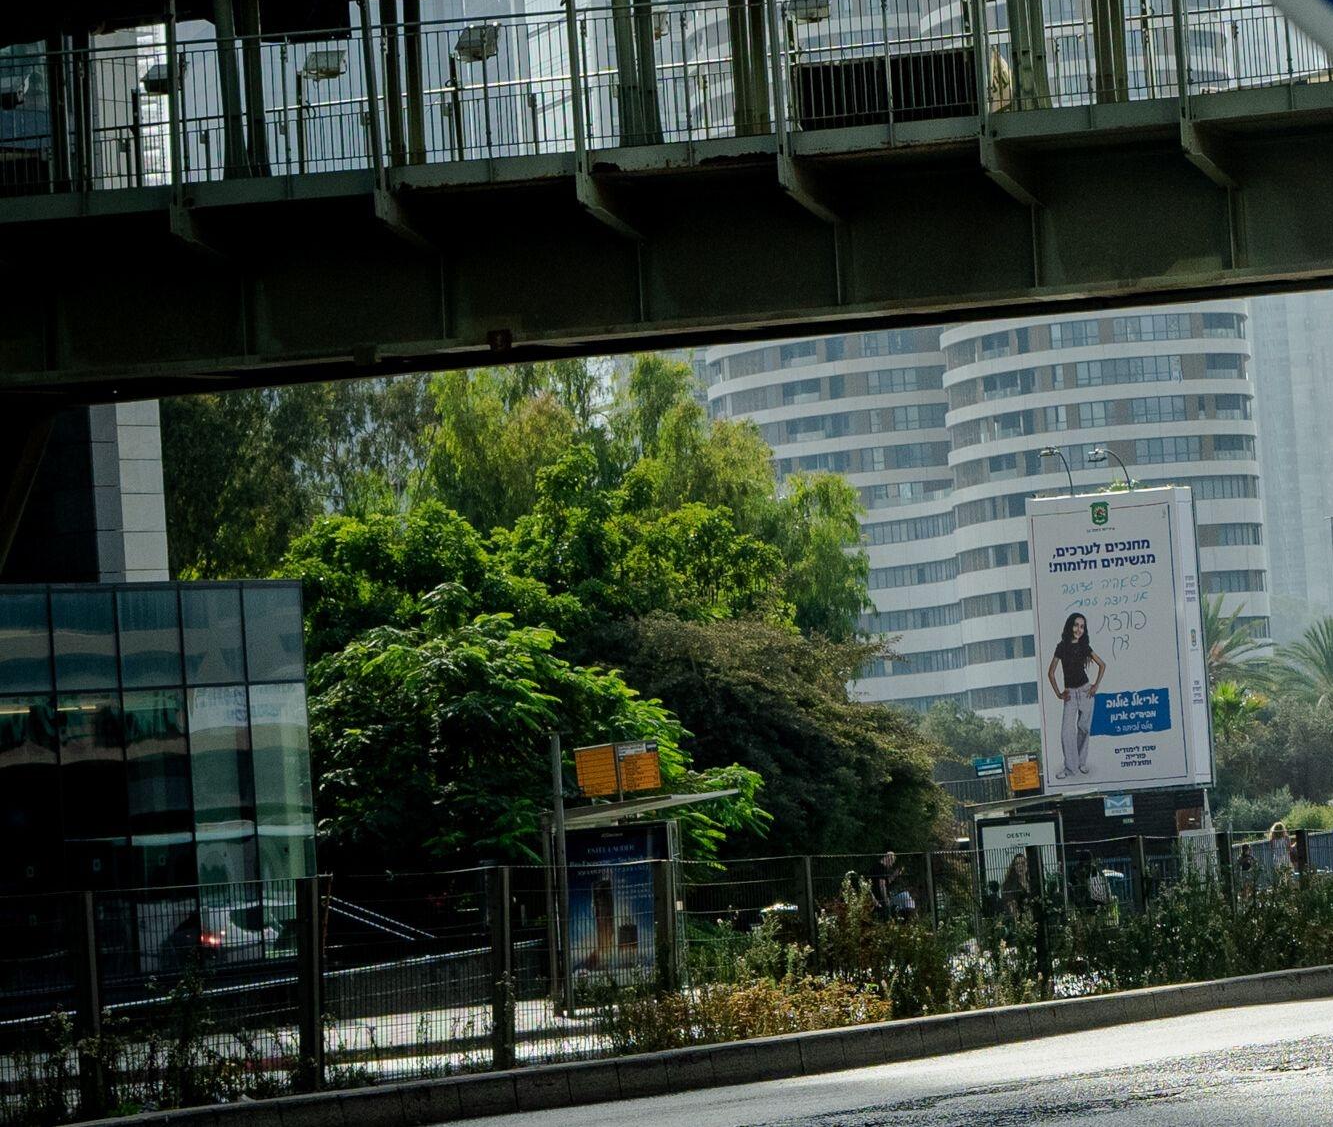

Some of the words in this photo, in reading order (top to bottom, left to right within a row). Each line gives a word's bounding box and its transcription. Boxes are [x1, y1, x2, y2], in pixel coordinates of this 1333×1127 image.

[1052, 542, 1102, 560] לערכים,
[1105, 538, 1151, 554] מחנכים
[1049, 558, 1098, 573] חלומות!
[1101, 553, 1156, 569] מגשימים
[1096, 610, 1147, 635] פורצת
[1131, 692, 1159, 707] אריאל
